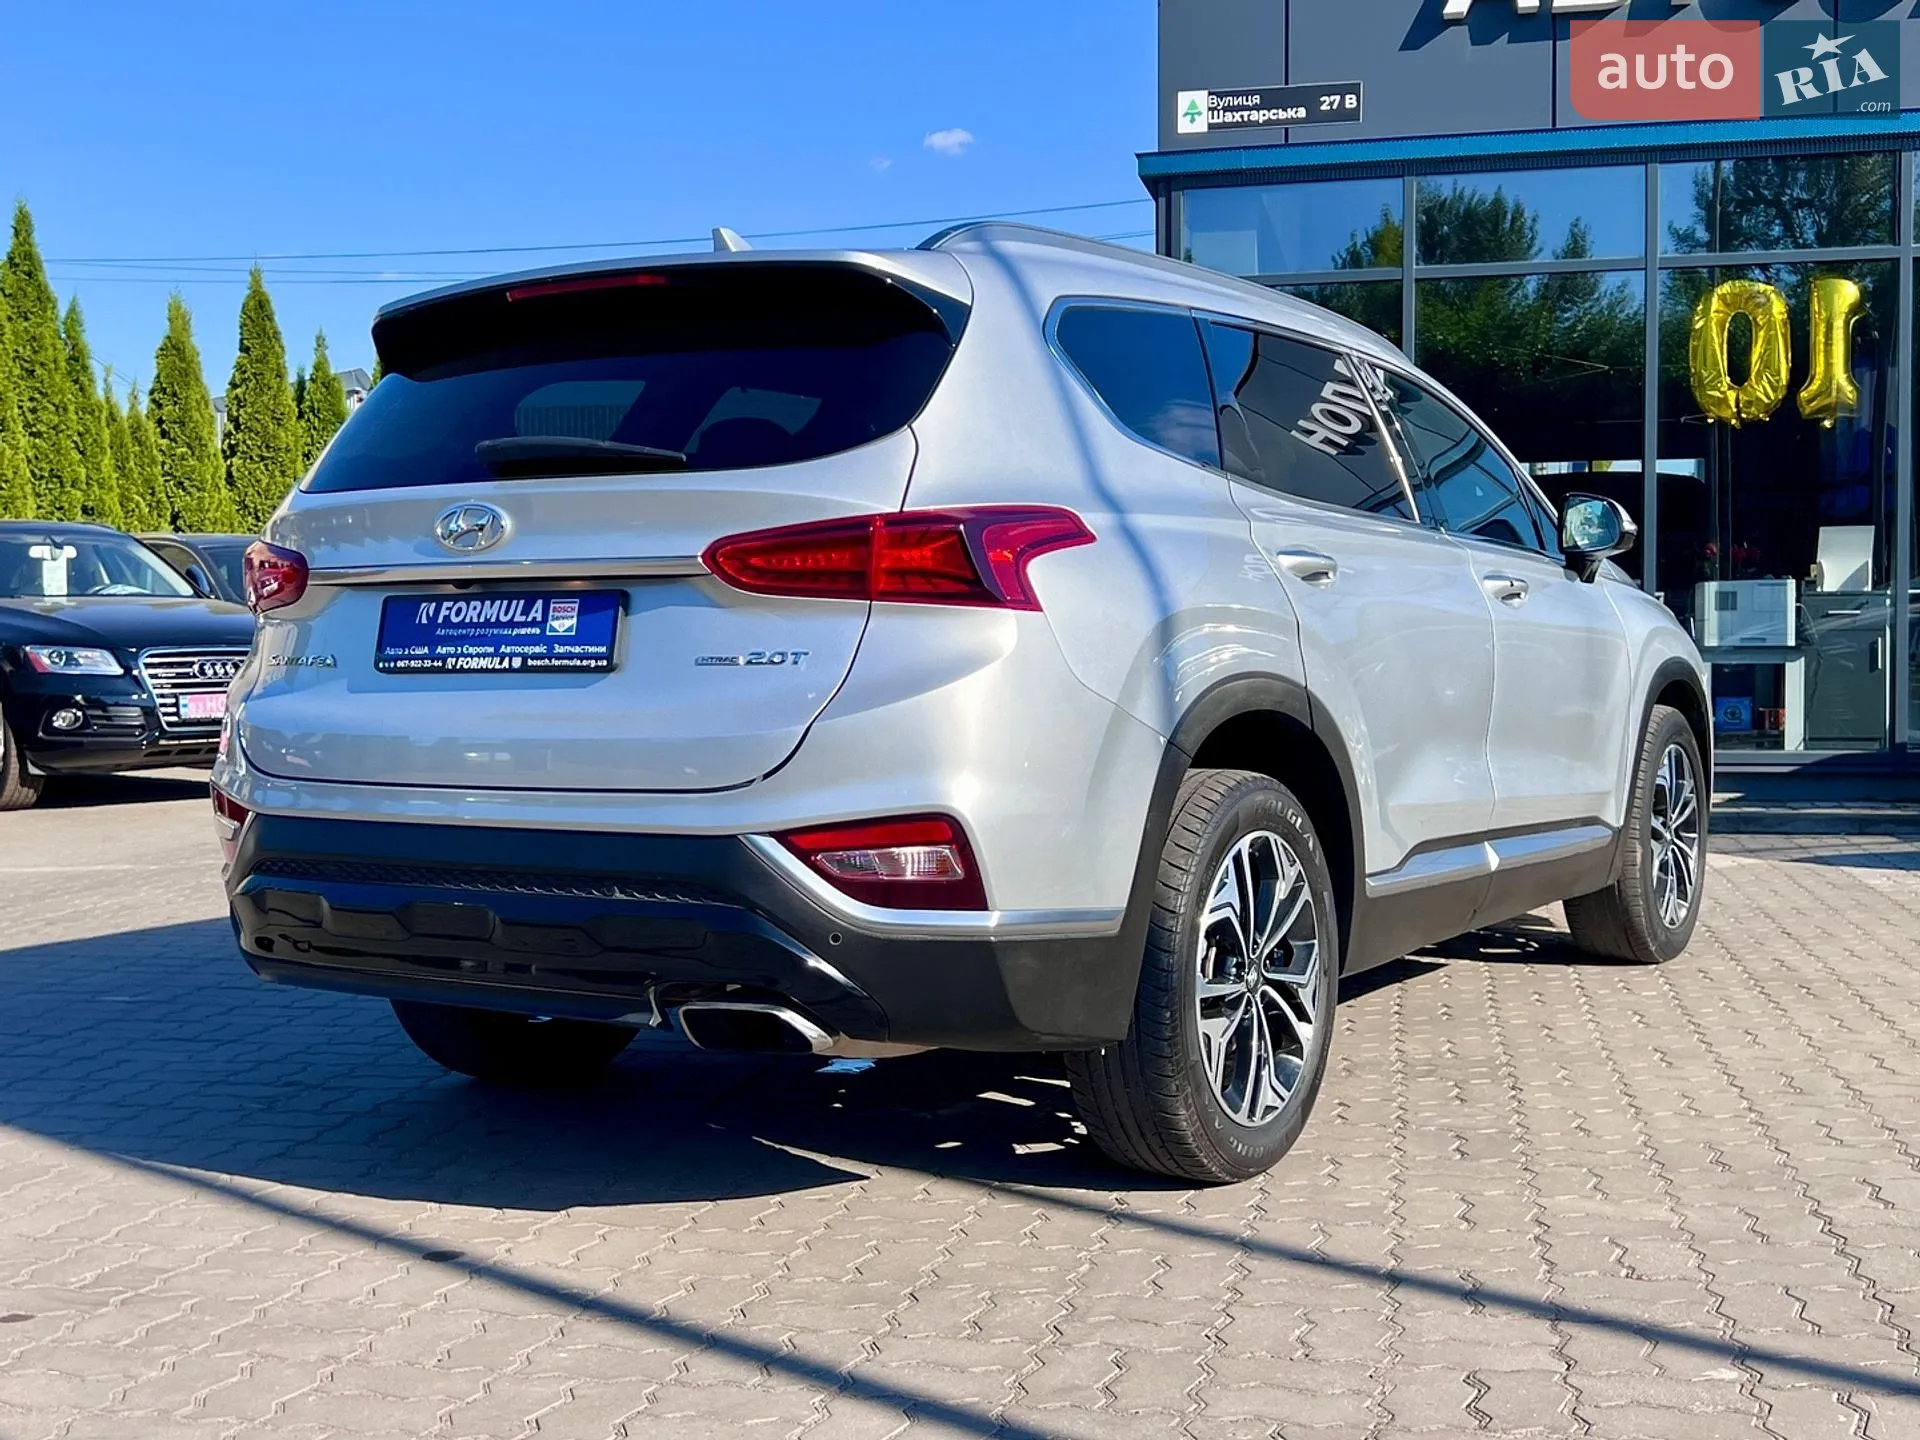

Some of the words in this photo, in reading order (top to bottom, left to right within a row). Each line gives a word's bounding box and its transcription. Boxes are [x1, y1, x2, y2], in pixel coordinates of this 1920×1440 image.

[1208, 94, 1260, 111] Вулиця
[1319, 95, 1341, 111] 27
[1208, 105, 1307, 124] Шахтарська
[437, 599, 543, 624] FORMULA
[551, 605, 576, 614] BOSCH
[409, 646, 429, 655] США
[436, 645, 455, 654] Авто
[463, 645, 495, 656] Європи
[499, 643, 548, 655] Автосервіс
[553, 643, 607, 654] Запчастини
[456, 656, 510, 669] FORMULA
